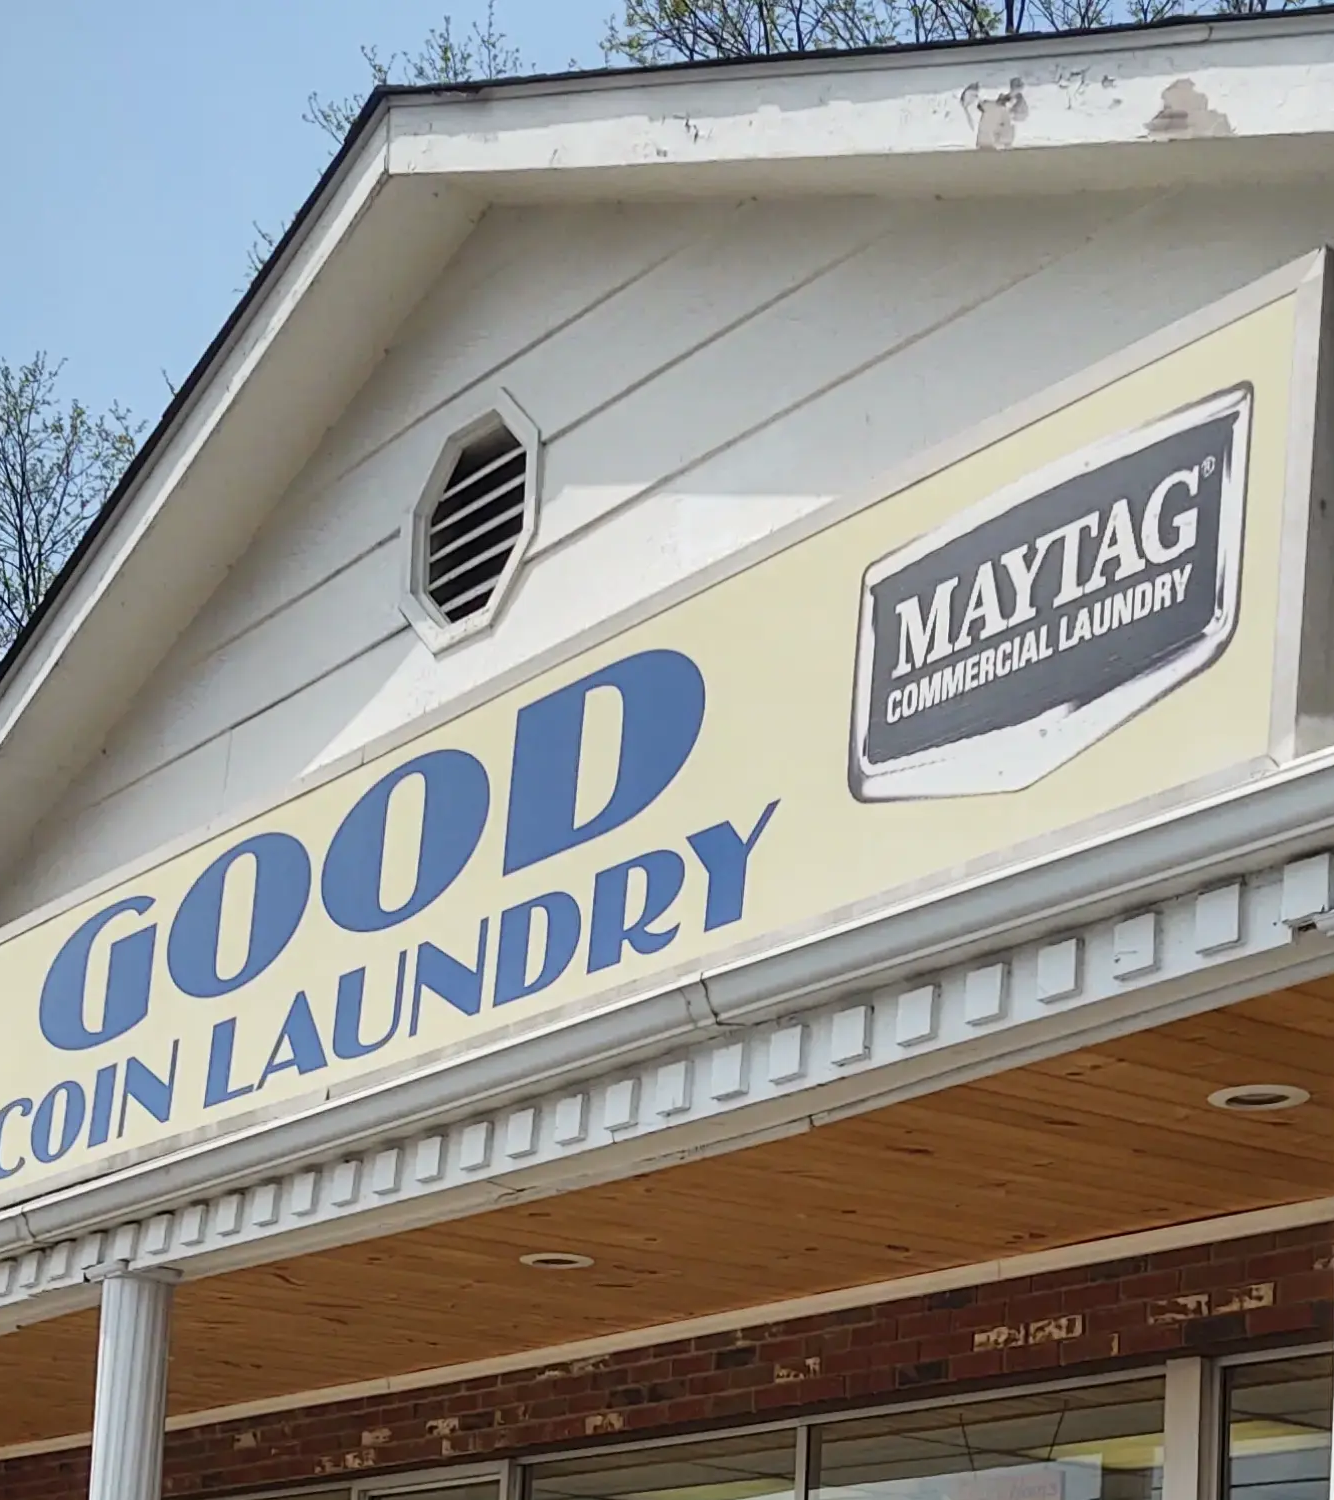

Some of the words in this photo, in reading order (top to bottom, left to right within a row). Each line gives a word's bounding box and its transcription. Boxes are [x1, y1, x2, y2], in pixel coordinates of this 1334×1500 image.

[886, 625, 1053, 725] COMMERCIAL
[1059, 563, 1194, 652] LAUNDRY
[892, 466, 1200, 679] MAYTAG
[38, 648, 706, 1051] GOOD
[202, 798, 782, 1110] LAUNDRY
